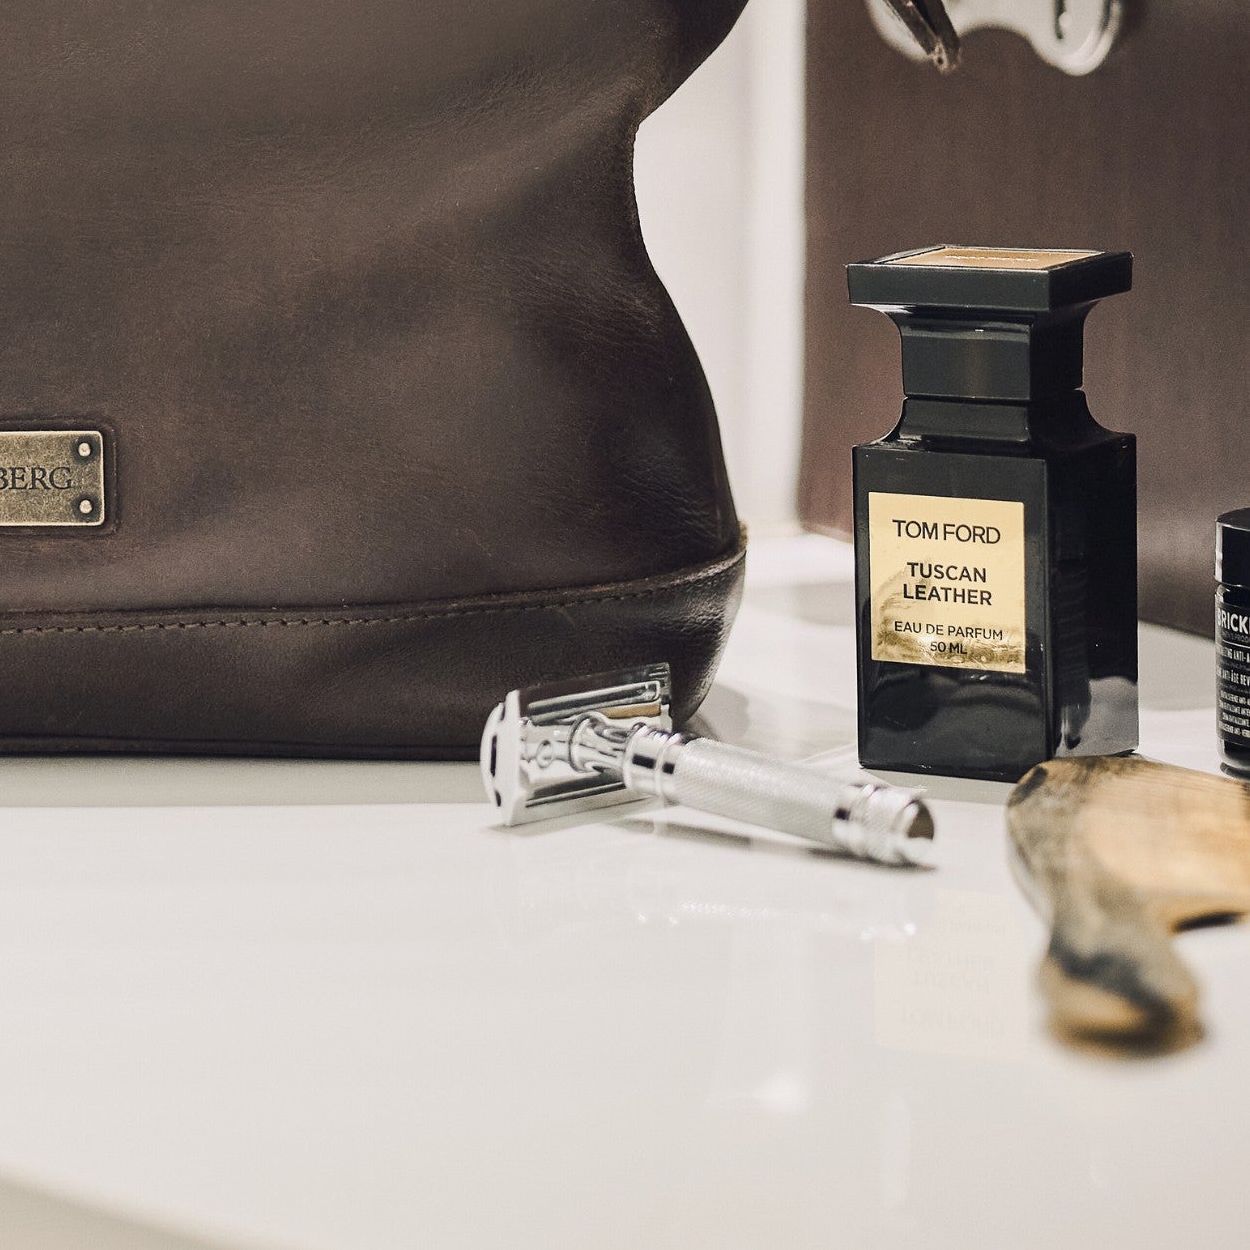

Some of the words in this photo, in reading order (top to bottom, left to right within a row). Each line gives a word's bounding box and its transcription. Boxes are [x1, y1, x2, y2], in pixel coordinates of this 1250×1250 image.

[892, 519, 939, 541] TOM
[943, 523, 1001, 545] FORD
[906, 562, 987, 583] TUSCAN
[903, 583, 993, 606] LEATHER
[894, 620, 922, 634] EAU
[926, 623, 944, 636] DE
[947, 625, 1003, 641] PARFUM
[1217, 607, 1250, 635] BRICK
[930, 641, 946, 653] 50
[949, 642, 968, 655] ML
